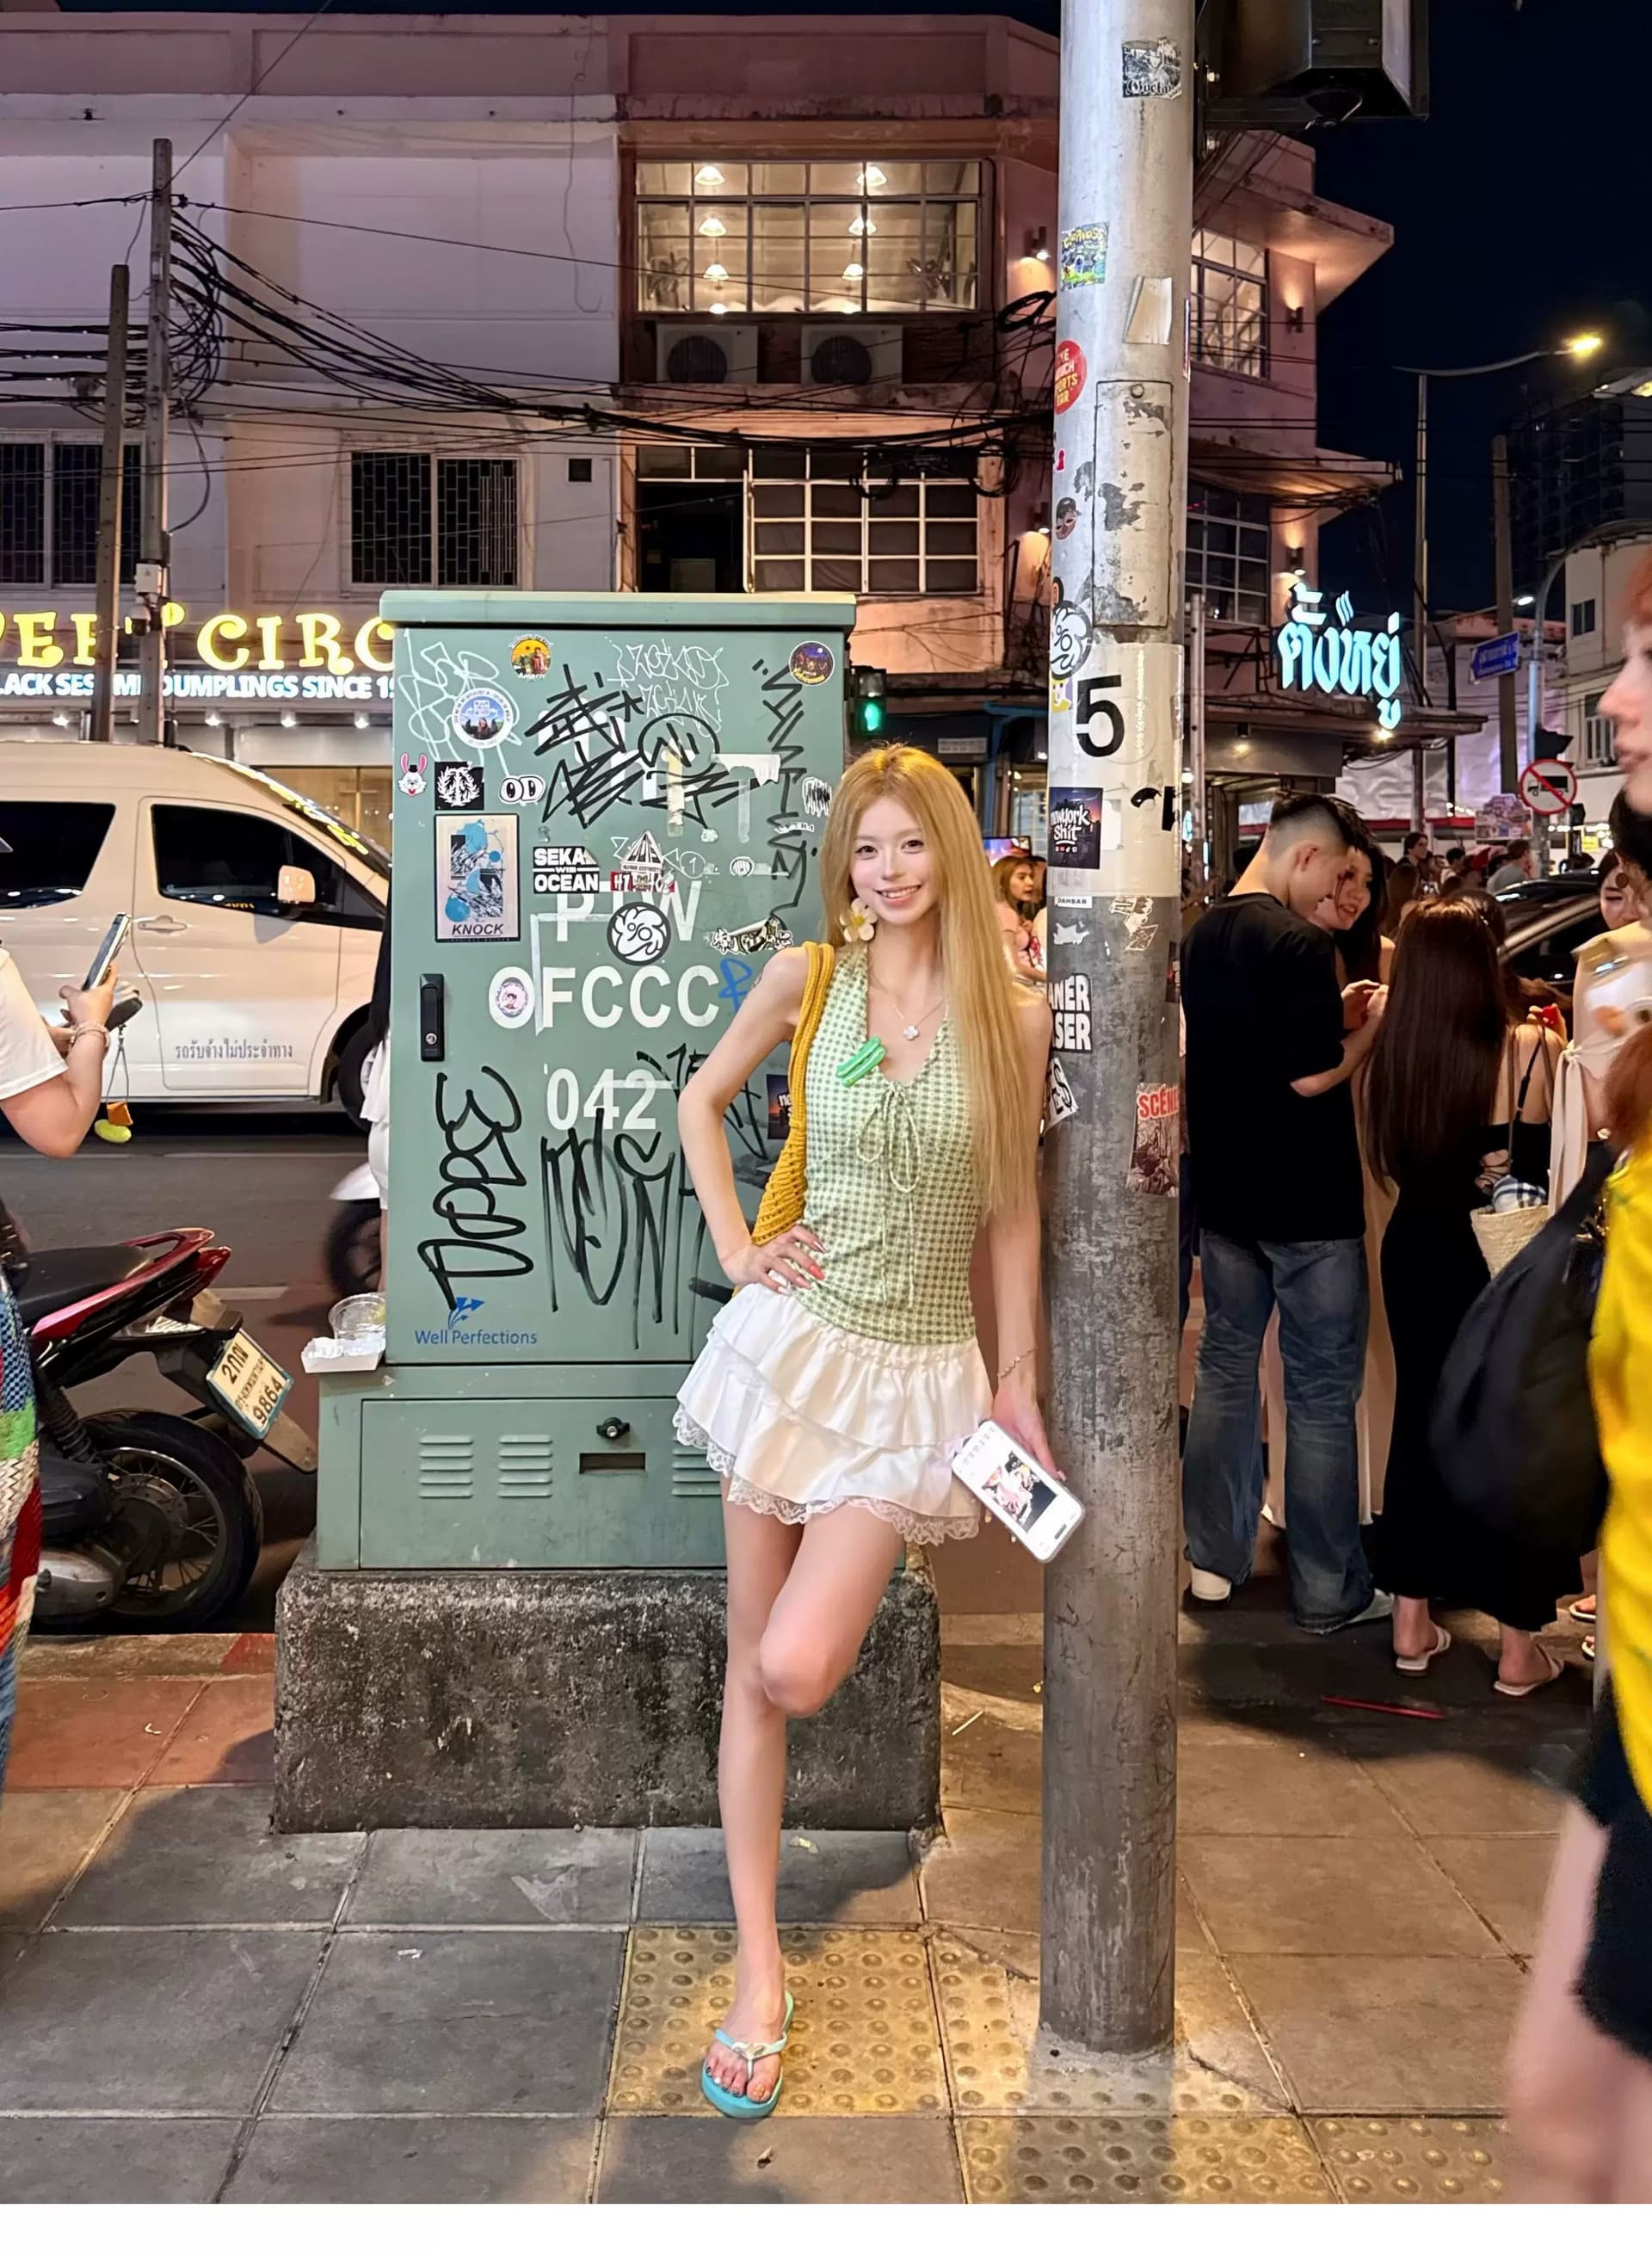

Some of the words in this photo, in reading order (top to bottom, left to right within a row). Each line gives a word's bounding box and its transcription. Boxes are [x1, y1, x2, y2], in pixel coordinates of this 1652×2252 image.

[302, 676, 372, 698] SINCE
[1076, 675, 1124, 758] 5
[534, 873, 599, 892] OCEAN
[452, 923, 503, 935] KNOCK
[488, 965, 719, 1029] OFCCC
[546, 1067, 656, 1131] 042
[415, 1330, 448, 1345] Well
[452, 1329, 538, 1345] Perfections
[252, 1375, 285, 1425] 9864
